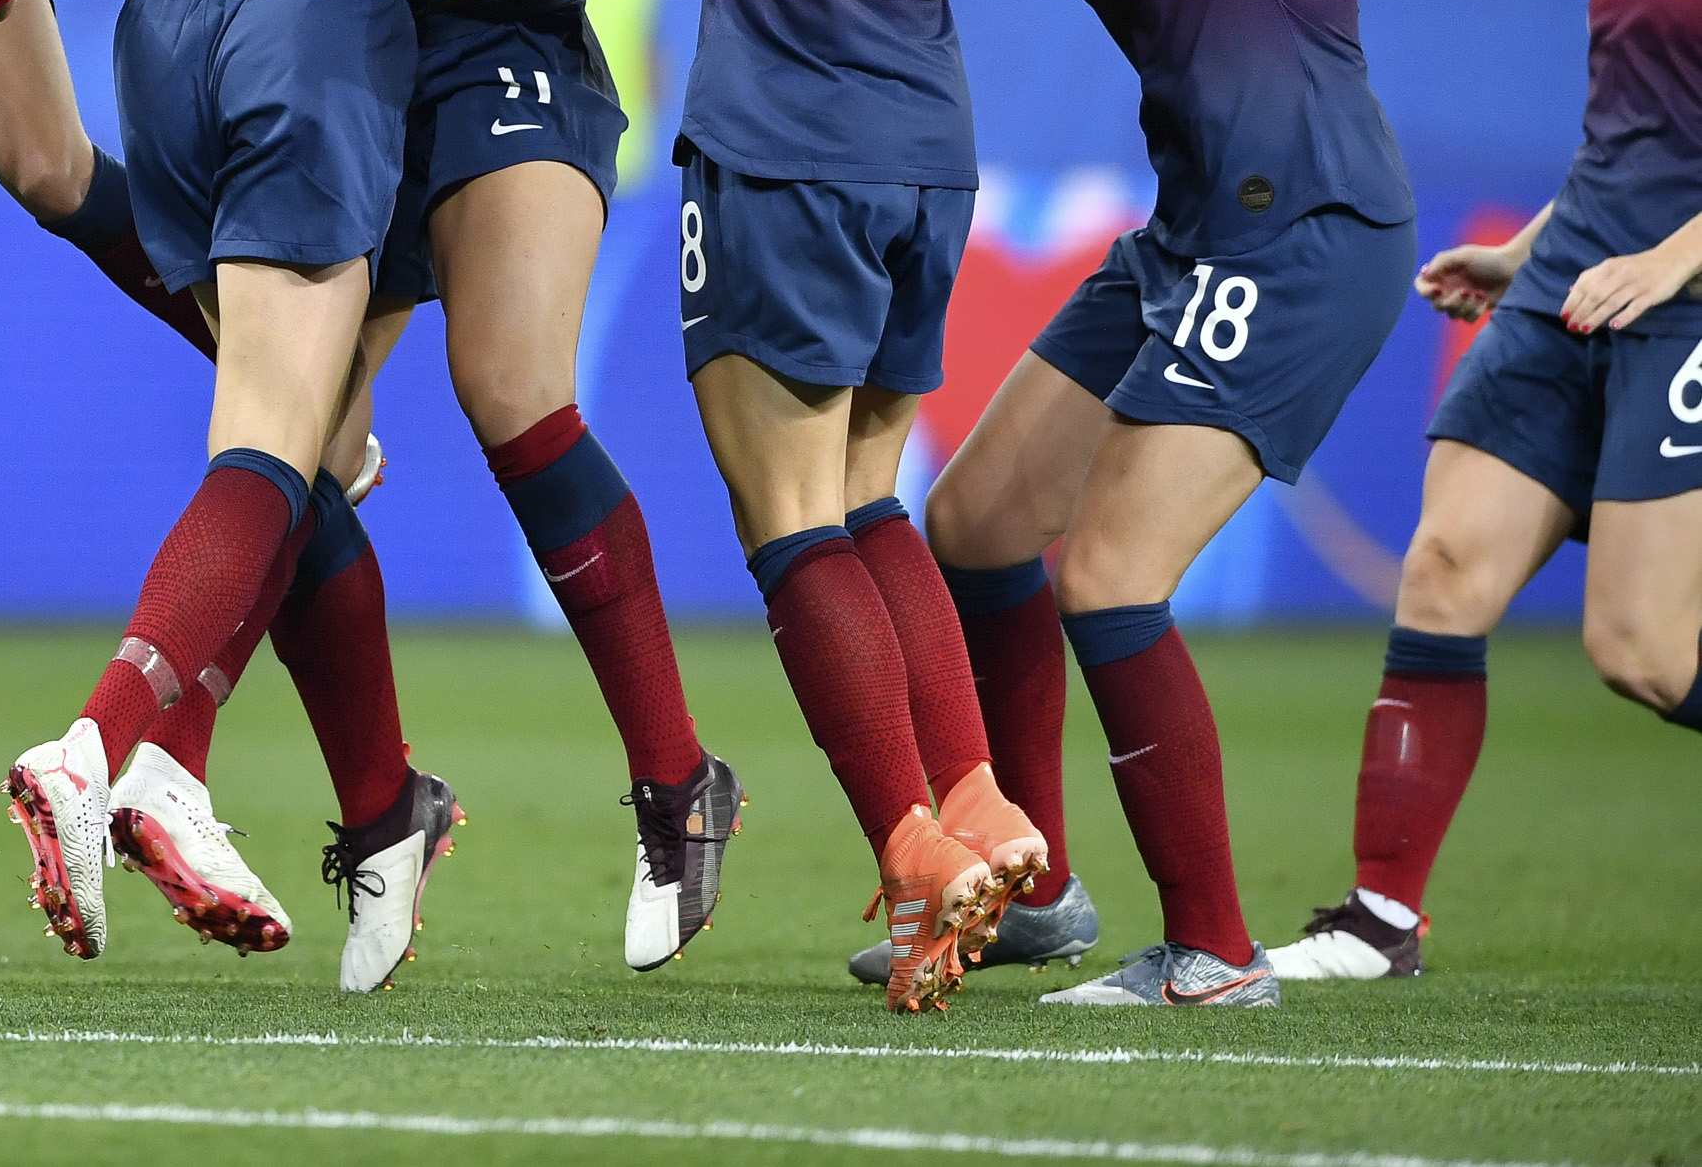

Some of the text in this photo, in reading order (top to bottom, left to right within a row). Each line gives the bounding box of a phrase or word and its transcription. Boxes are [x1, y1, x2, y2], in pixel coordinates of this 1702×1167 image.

[497, 66, 552, 105] 11
[681, 200, 707, 293] 8
[1172, 263, 1259, 362] 18
